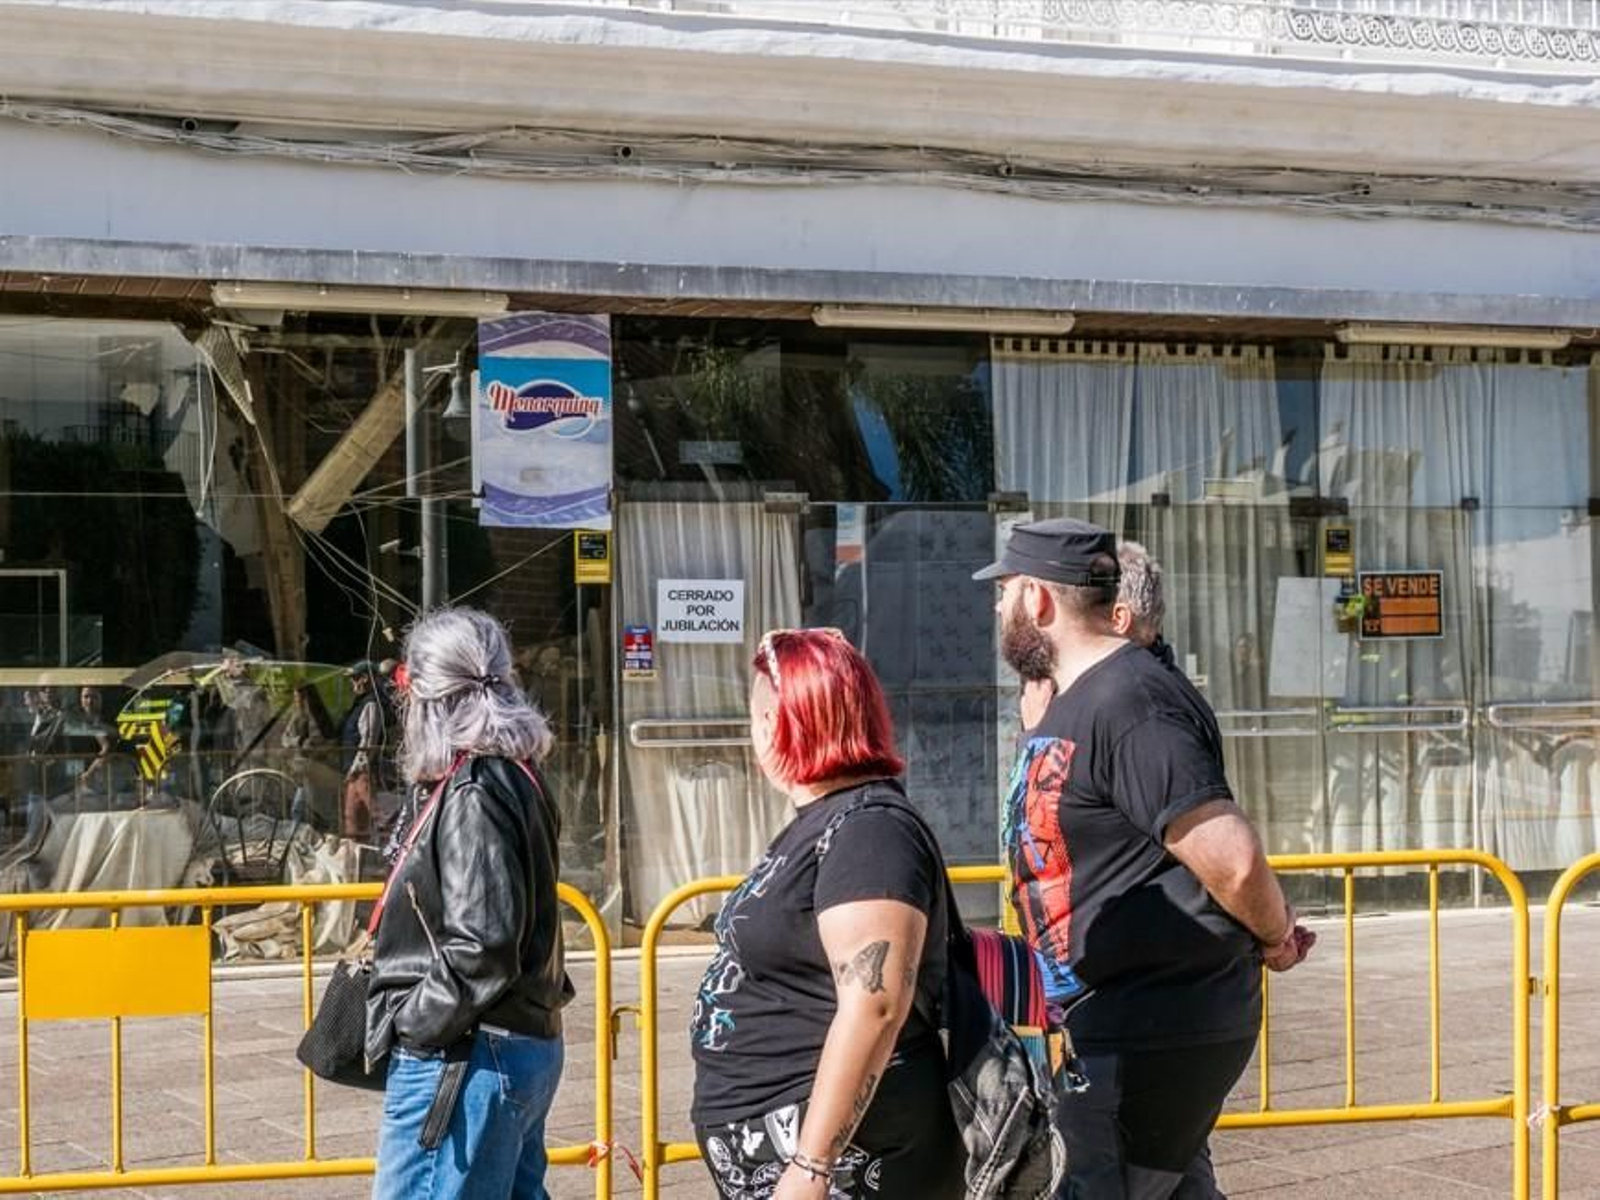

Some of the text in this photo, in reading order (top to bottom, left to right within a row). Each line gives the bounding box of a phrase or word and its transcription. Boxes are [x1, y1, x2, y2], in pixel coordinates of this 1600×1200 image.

[1363, 575, 1438, 596] SE VENDE
[667, 589, 734, 602] CERRADO
[686, 604, 715, 616] POR
[661, 617, 740, 632] JUBILACIÓN
